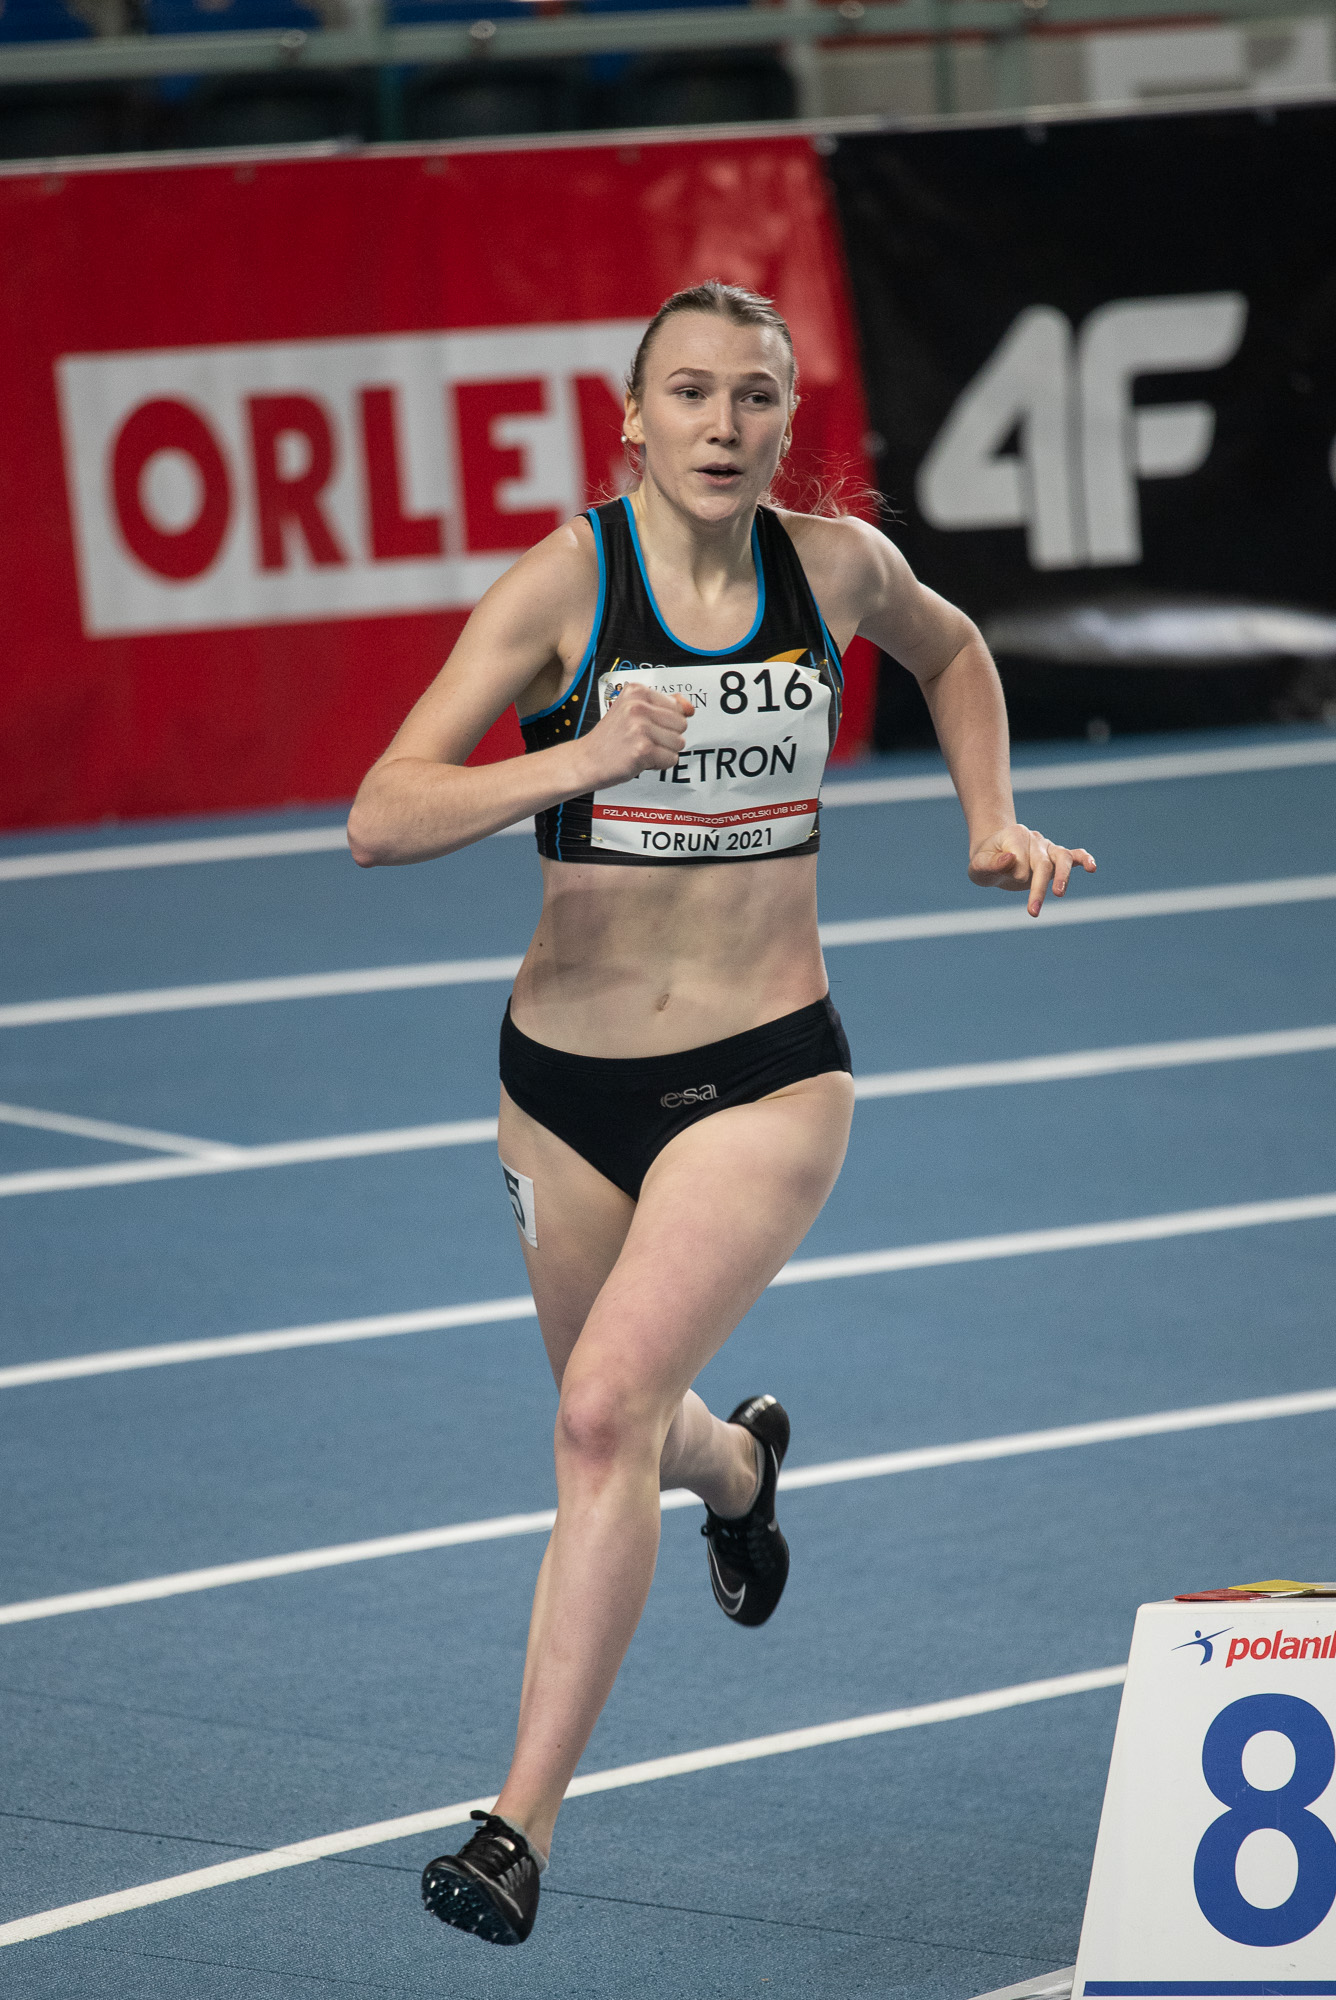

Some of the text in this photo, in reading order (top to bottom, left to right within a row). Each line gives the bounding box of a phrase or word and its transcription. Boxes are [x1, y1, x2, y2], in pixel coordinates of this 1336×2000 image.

[915, 290, 1249, 571] 4F
[719, 669, 813, 715] 816
[633, 736, 797, 784] ETROŃ
[603, 803, 809, 825] PZLA HALOWE MISTRZOSTWA POLSKI U18 U20
[641, 827, 772, 852] TORUŃ 2021
[660, 1083, 719, 1109] esa
[502, 1165, 526, 1231] 5
[1193, 1692, 1336, 1947] 8
